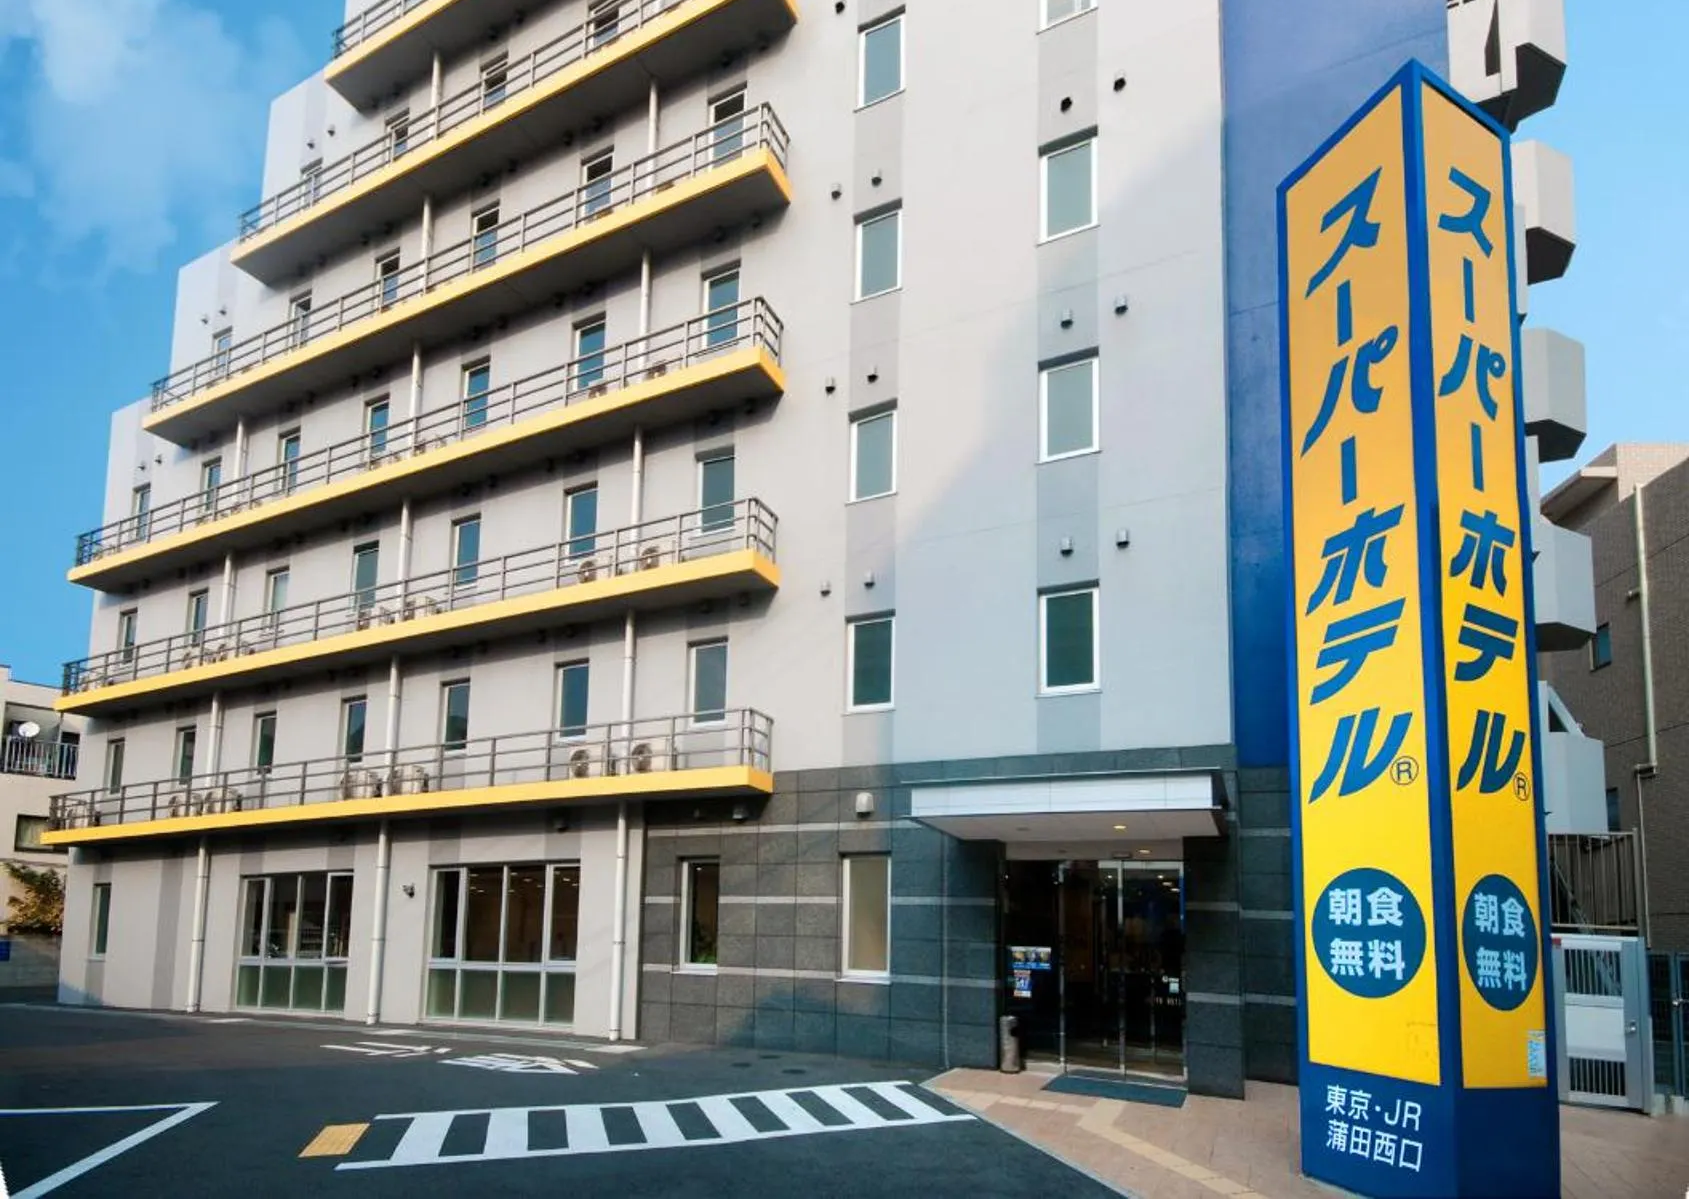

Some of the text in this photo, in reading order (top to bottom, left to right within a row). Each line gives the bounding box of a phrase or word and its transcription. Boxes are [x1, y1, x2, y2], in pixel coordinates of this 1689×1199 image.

[1328, 886, 1404, 928] 朝食
[1474, 892, 1526, 939] 朝食
[1329, 937, 1406, 981] 無料
[1475, 946, 1528, 992] 無料
[1326, 1118, 1423, 1173] 蒲田西口
